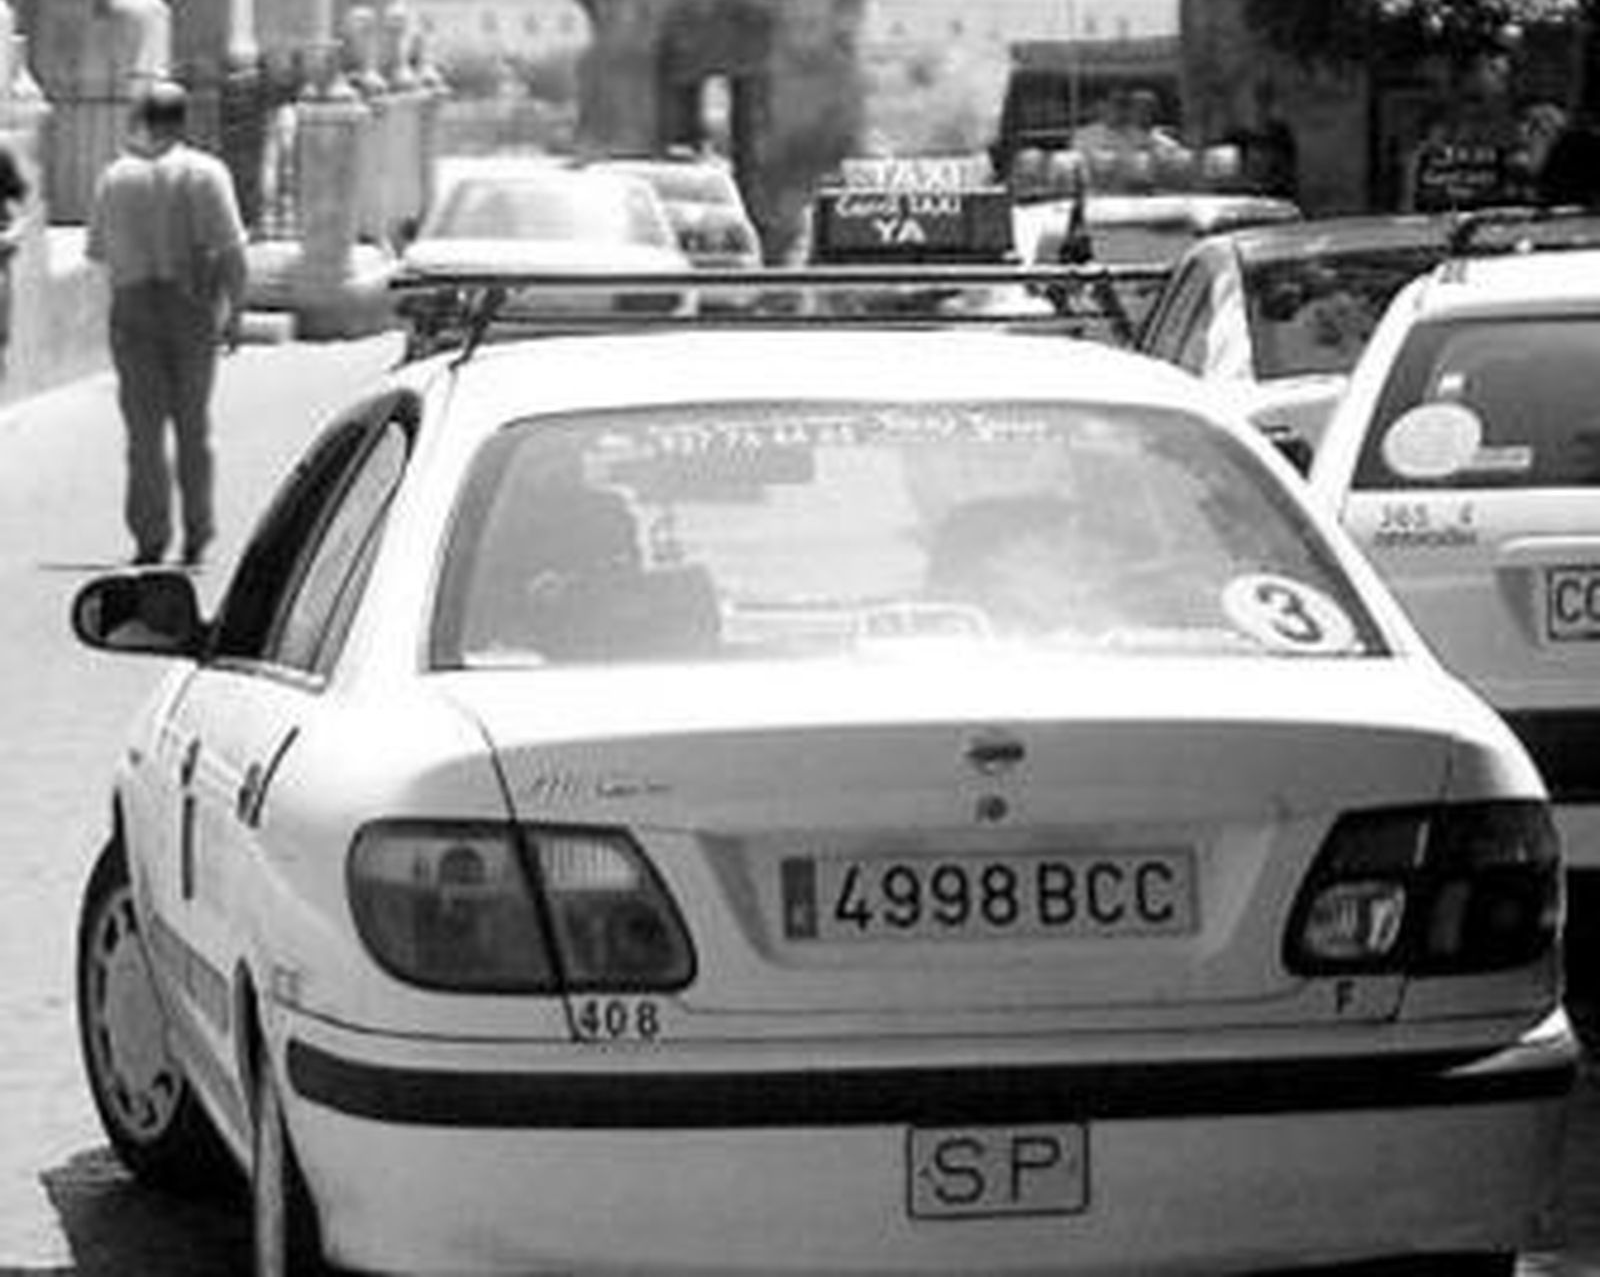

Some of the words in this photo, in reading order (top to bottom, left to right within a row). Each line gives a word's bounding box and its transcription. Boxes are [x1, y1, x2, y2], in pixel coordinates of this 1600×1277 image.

[873, 219, 927, 244] YA
[1256, 583, 1323, 643] 3
[834, 864, 1019, 931] 4998
[1037, 860, 1174, 925] BCC
[578, 1000, 661, 1040] 408
